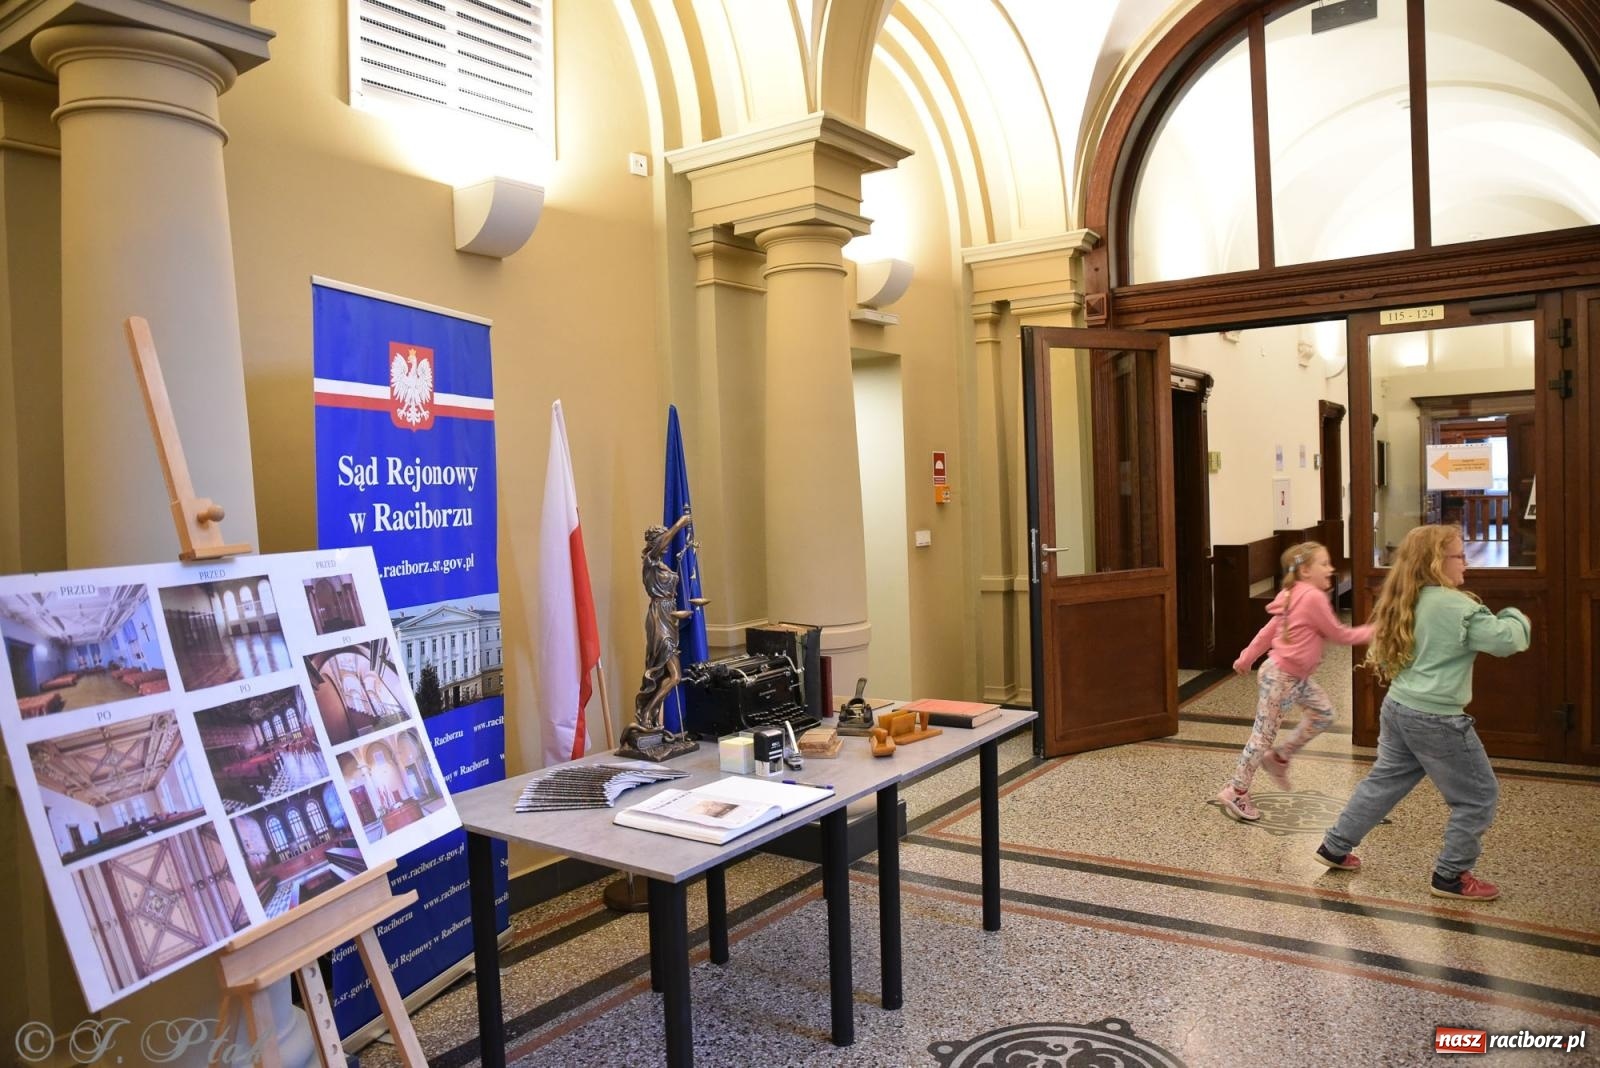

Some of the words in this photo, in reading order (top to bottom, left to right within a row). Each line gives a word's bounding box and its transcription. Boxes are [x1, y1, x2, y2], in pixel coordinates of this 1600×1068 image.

[1388, 311, 1405, 321] 115
[1416, 308, 1434, 319] 124
[338, 455, 379, 492] Sąd
[386, 456, 478, 493] Rejonowy
[349, 512, 367, 534] w
[372, 502, 473, 532] Raciborzu
[198, 569, 226, 580] PRZED
[59, 584, 96, 597] PRZED
[239, 684, 251, 694] PO
[97, 710, 112, 722] PO
[390, 842, 465, 887] www.raciborz.sr.gov.pl
[376, 911, 413, 937] Raciborzu
[400, 939, 433, 965] Rejonowy
